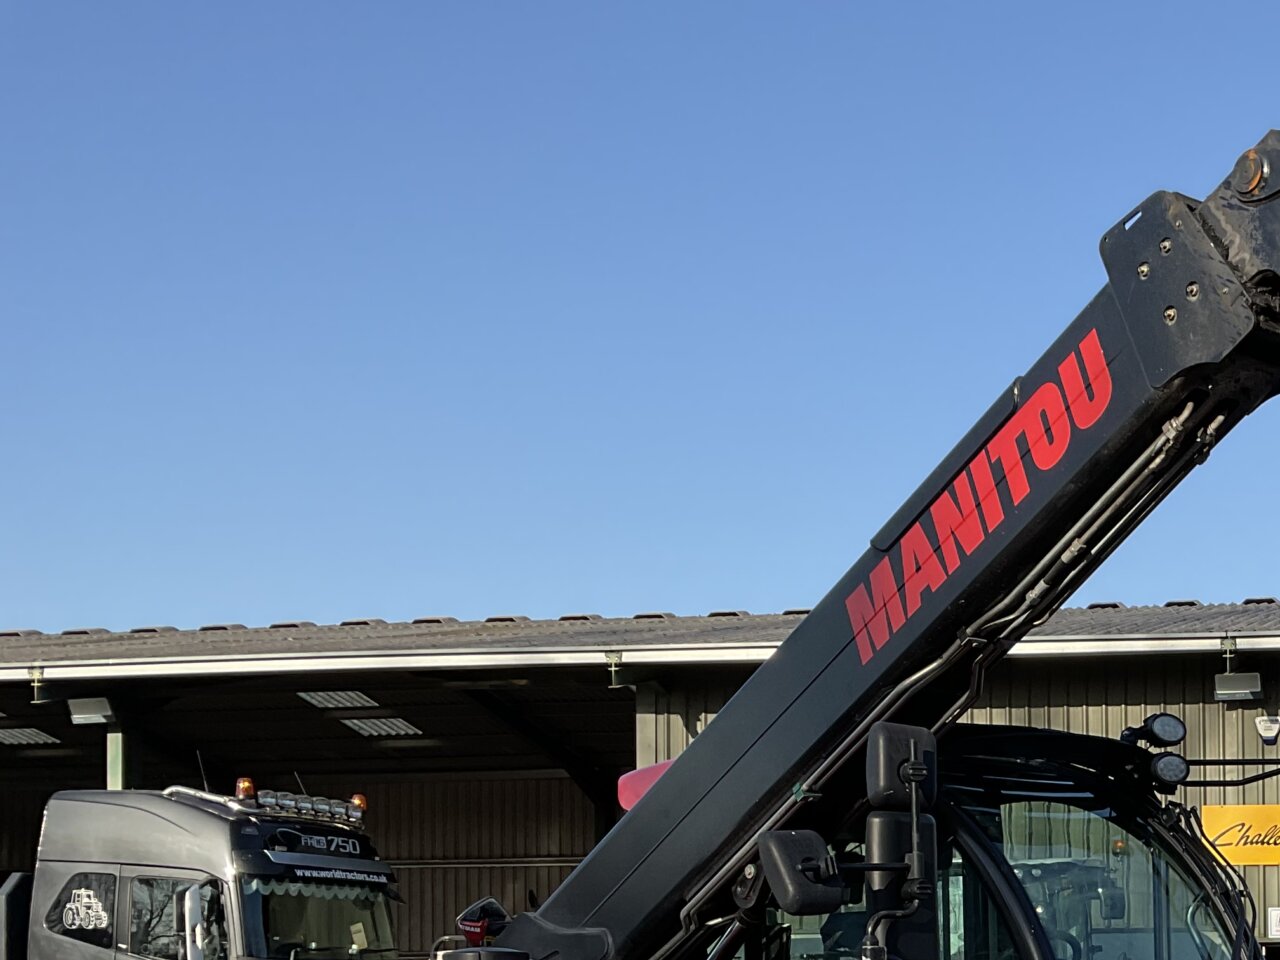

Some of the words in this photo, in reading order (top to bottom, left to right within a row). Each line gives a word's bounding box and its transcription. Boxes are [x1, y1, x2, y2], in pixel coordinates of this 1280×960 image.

[845, 328, 1112, 666] MANITOU
[327, 836, 360, 854] 750
[294, 868, 388, 884] www.worldtractors.co.uk
